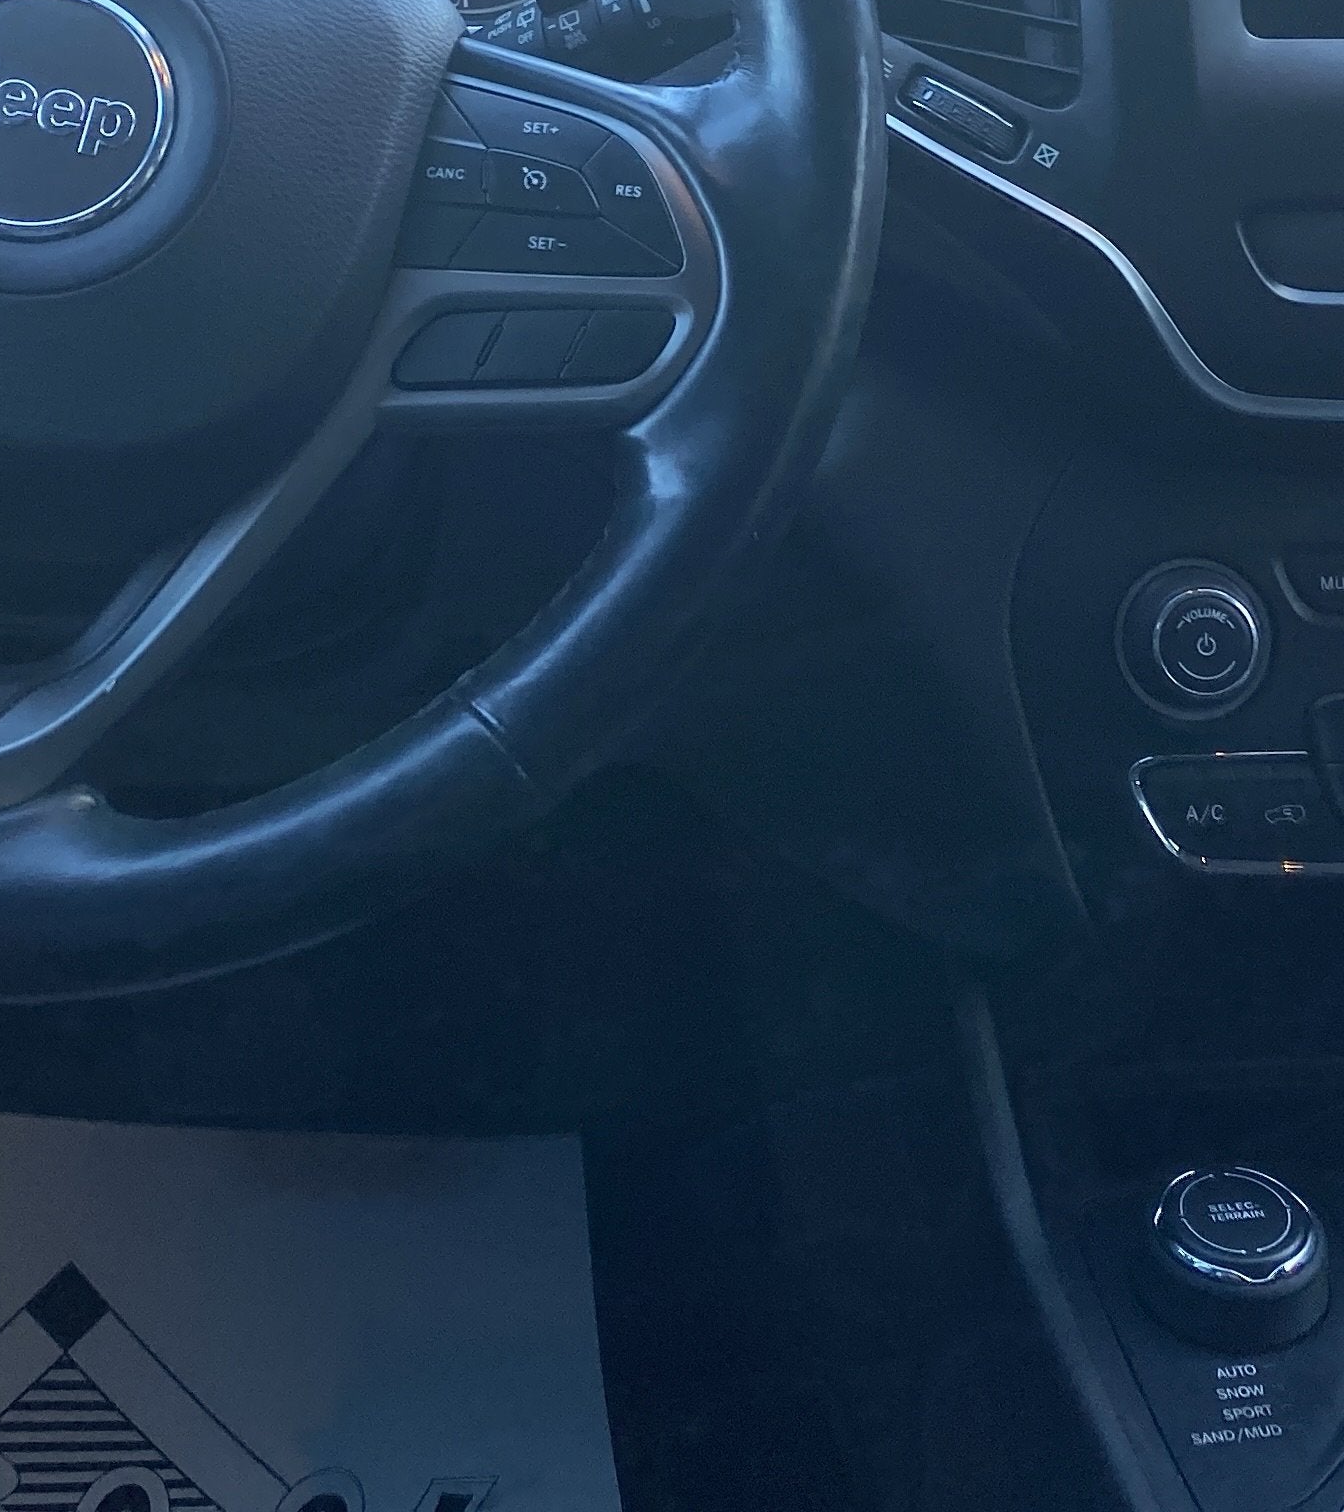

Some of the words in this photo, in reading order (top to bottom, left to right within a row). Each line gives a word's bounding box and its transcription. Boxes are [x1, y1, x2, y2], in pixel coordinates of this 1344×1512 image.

[425, 167, 465, 180] CANC
[614, 184, 642, 198] RES
[1181, 608, 1228, 624] VOLUME
[1185, 803, 1224, 824] A/C
[1210, 1209, 1266, 1223] TERRAIN
[1216, 1363, 1257, 1379] AUTO
[1216, 1384, 1265, 1401] SNOW
[1222, 1404, 1274, 1422] SPORT
[1190, 1423, 1283, 1447] SAND/MUD
